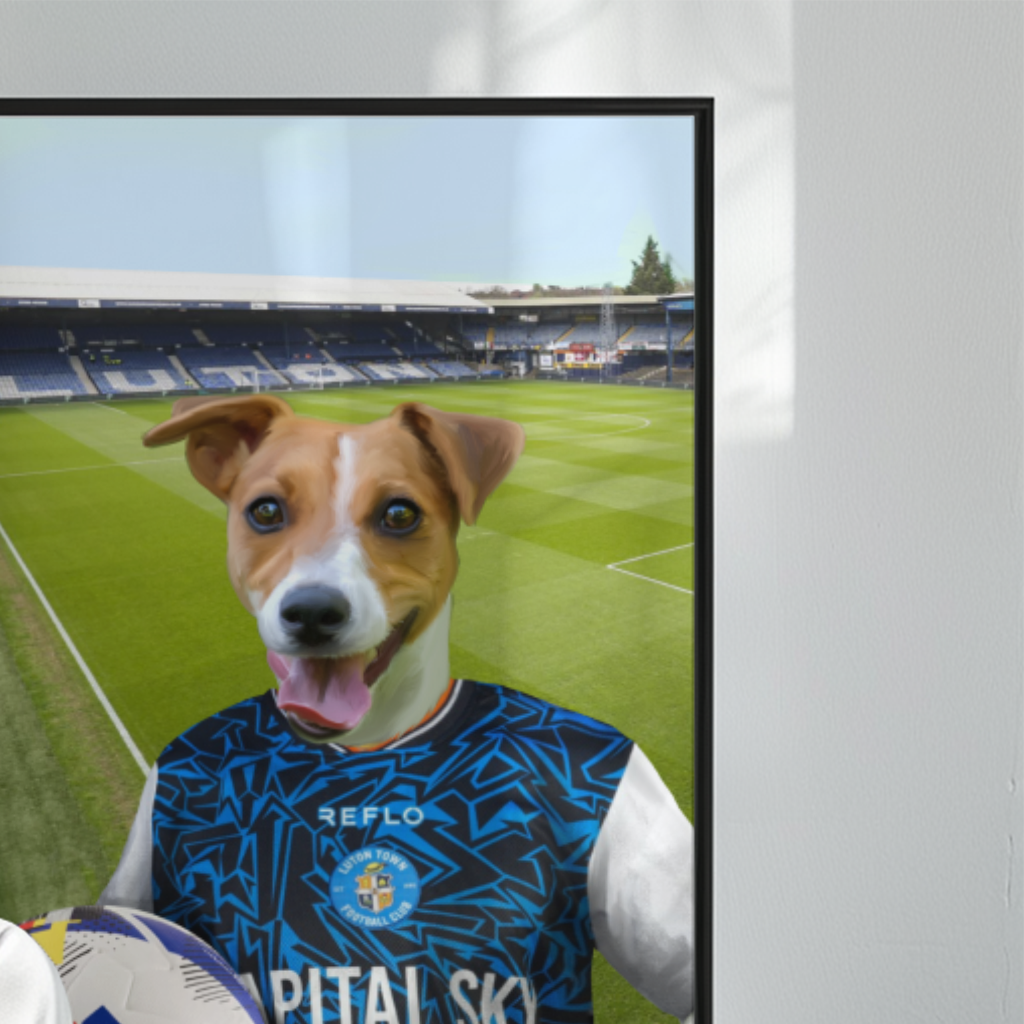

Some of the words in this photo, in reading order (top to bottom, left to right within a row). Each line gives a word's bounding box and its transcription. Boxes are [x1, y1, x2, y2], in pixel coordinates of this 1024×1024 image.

[317, 806, 425, 827] REFLO
[338, 851, 373, 875] LUTON
[376, 849, 409, 872] TOWN
[340, 904, 390, 927] FOOTBALL
[389, 901, 413, 923] CLUB
